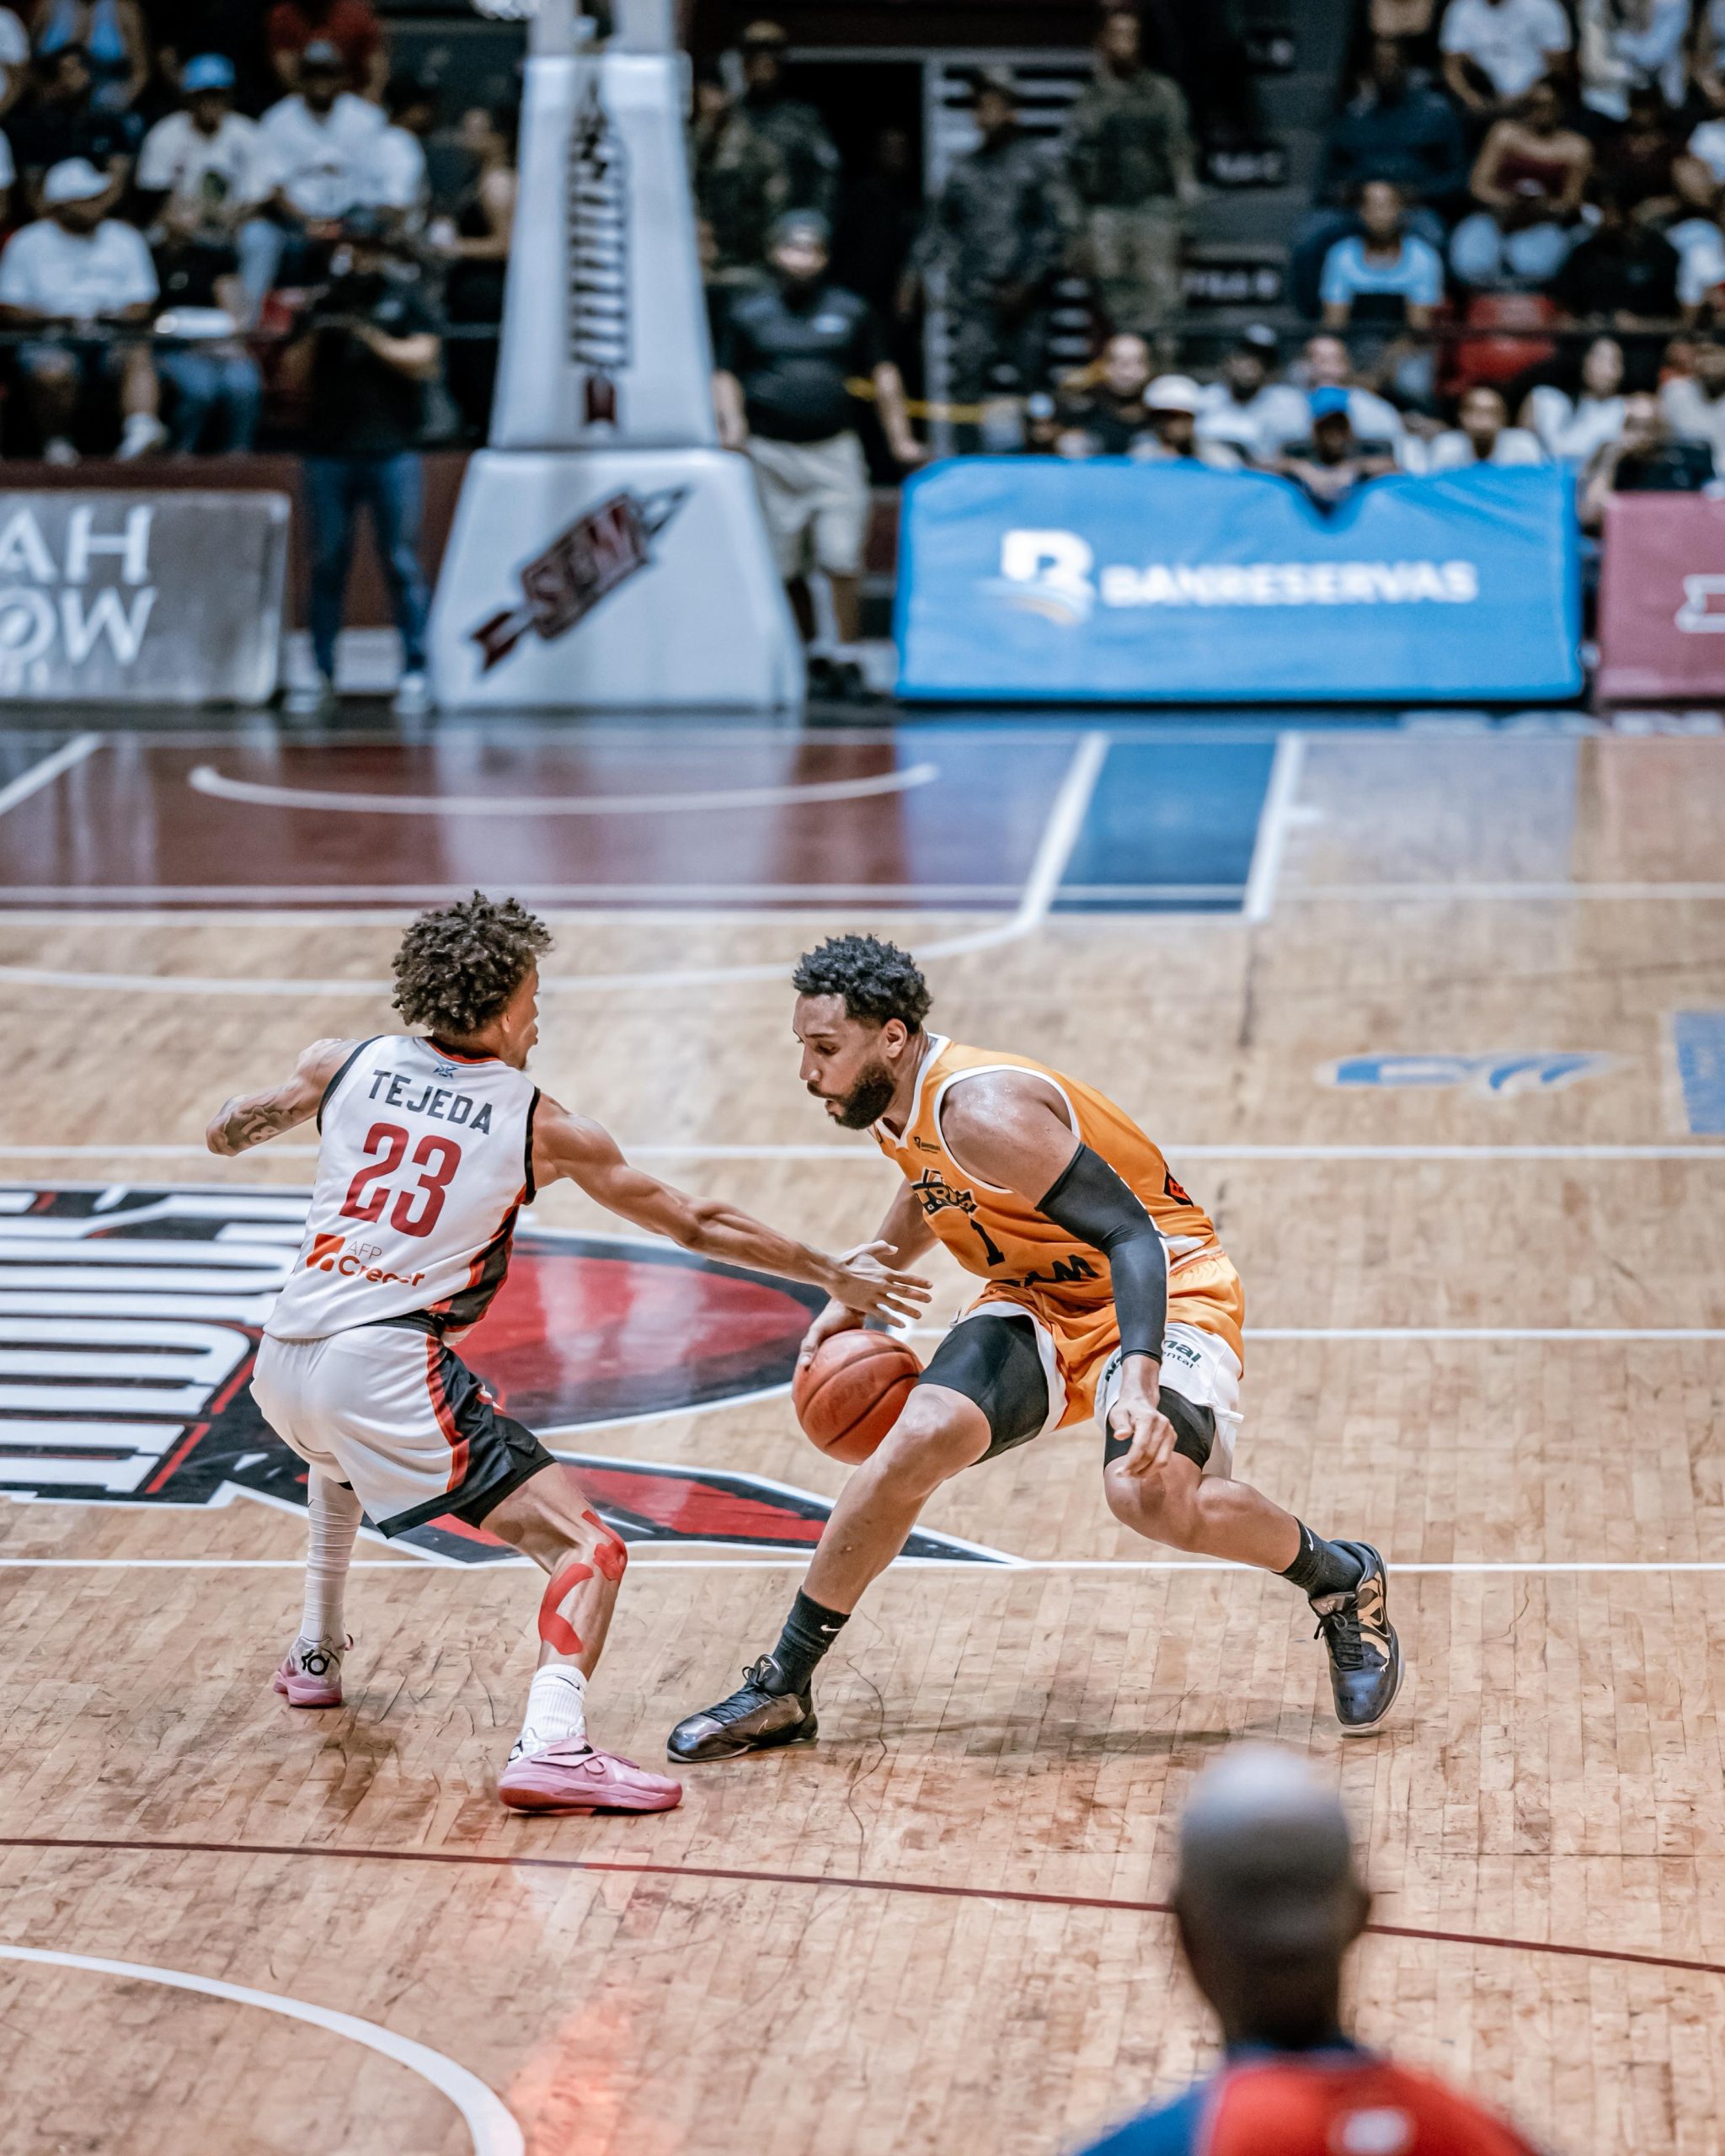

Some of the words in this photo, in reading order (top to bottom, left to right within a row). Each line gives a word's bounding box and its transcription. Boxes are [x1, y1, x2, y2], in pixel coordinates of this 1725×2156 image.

[1100, 562, 1479, 607] BANRESERVAS
[369, 1069, 494, 1135] TEJEDA
[339, 1122, 462, 1238] 23
[346, 1241, 382, 1260] AFP
